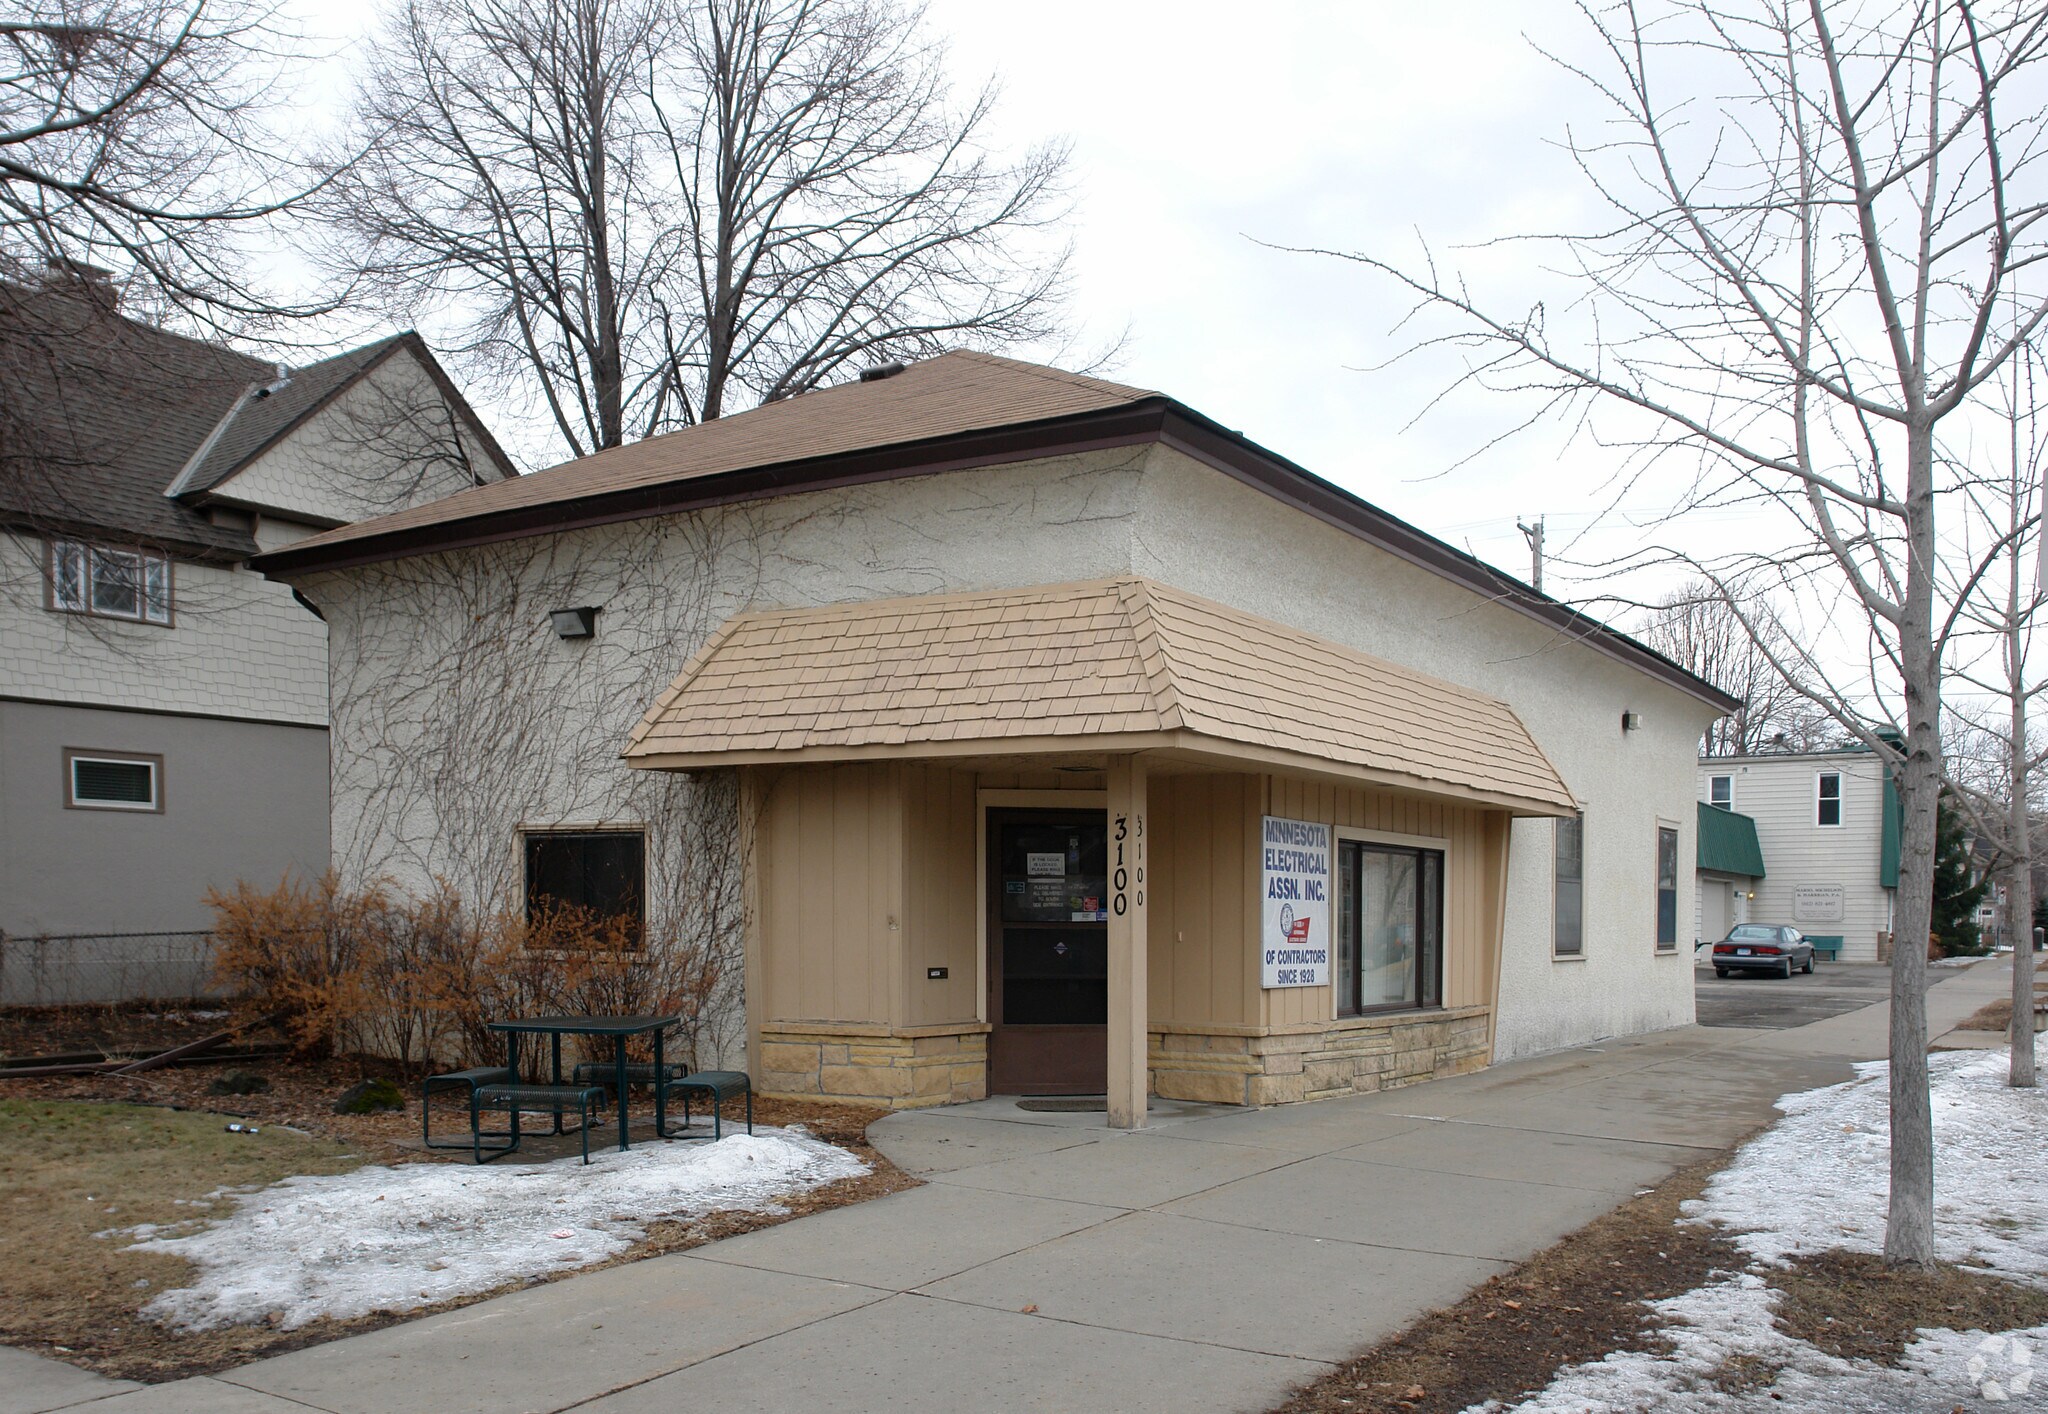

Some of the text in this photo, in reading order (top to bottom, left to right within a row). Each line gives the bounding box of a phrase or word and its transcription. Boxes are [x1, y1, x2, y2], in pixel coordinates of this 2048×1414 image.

[1265, 820, 1327, 848] MINNESOTA
[1114, 817, 1127, 916] 3100
[1265, 848, 1327, 875] ELECTRICAL
[1268, 876, 1325, 901] ASSN. INC.
[1266, 949, 1326, 965] OF CONTRACTORS
[1278, 968, 1315, 984] SINCE 1928
